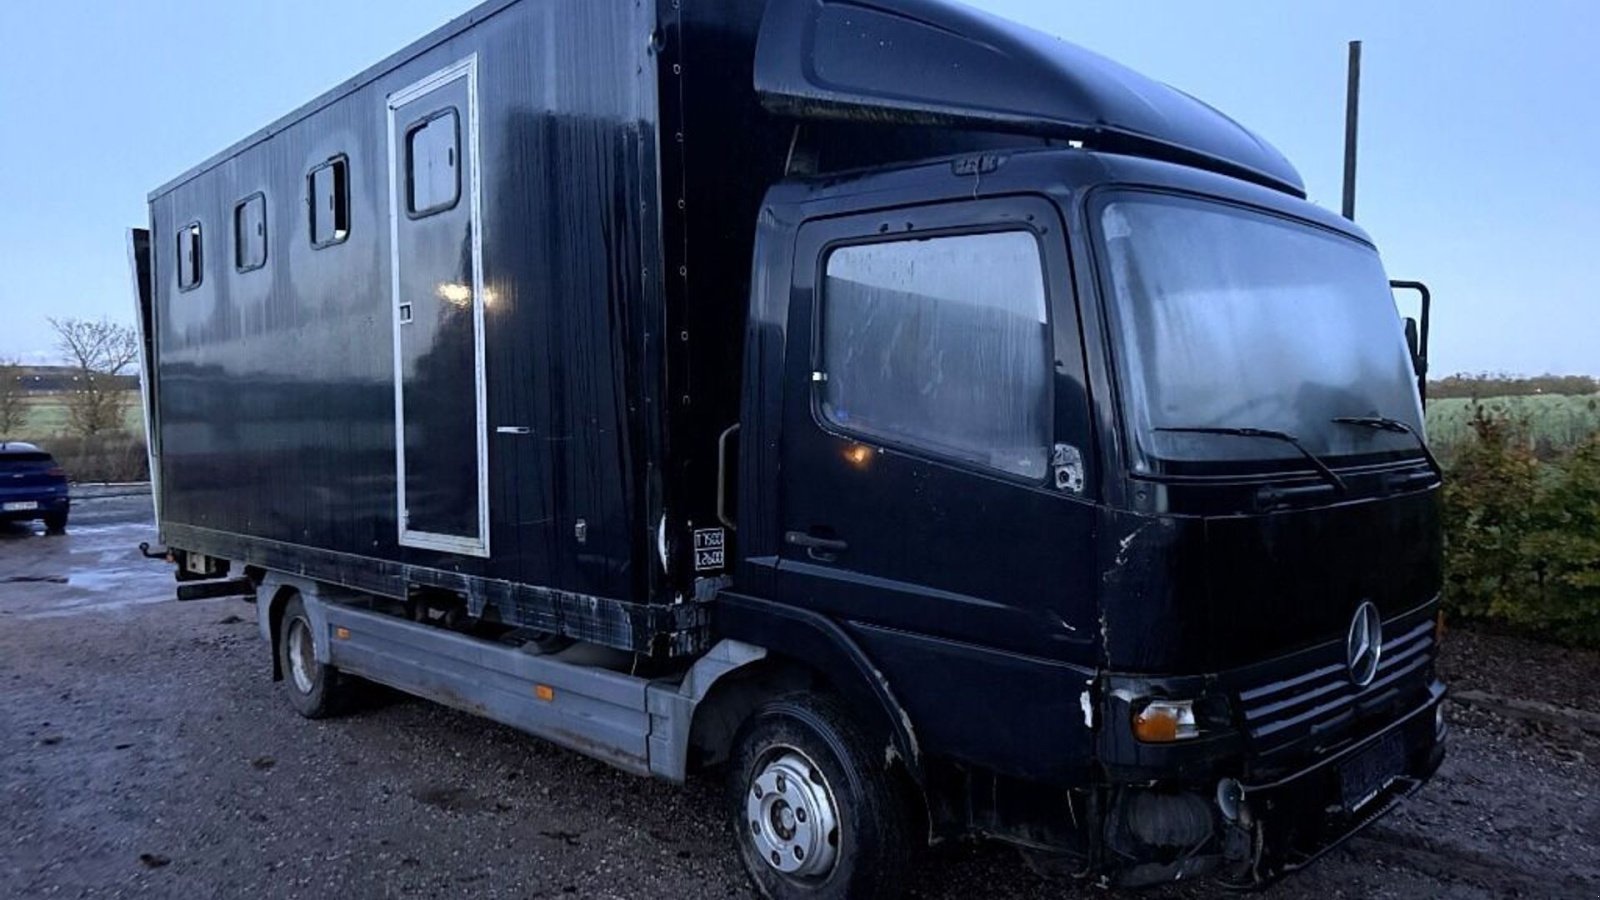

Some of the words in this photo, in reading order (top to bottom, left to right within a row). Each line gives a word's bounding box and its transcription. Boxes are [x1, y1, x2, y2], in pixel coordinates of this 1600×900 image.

[695, 534, 701, 546] T
[703, 532, 722, 546] 7500
[696, 553, 701, 565] L
[702, 551, 723, 565] 2600
